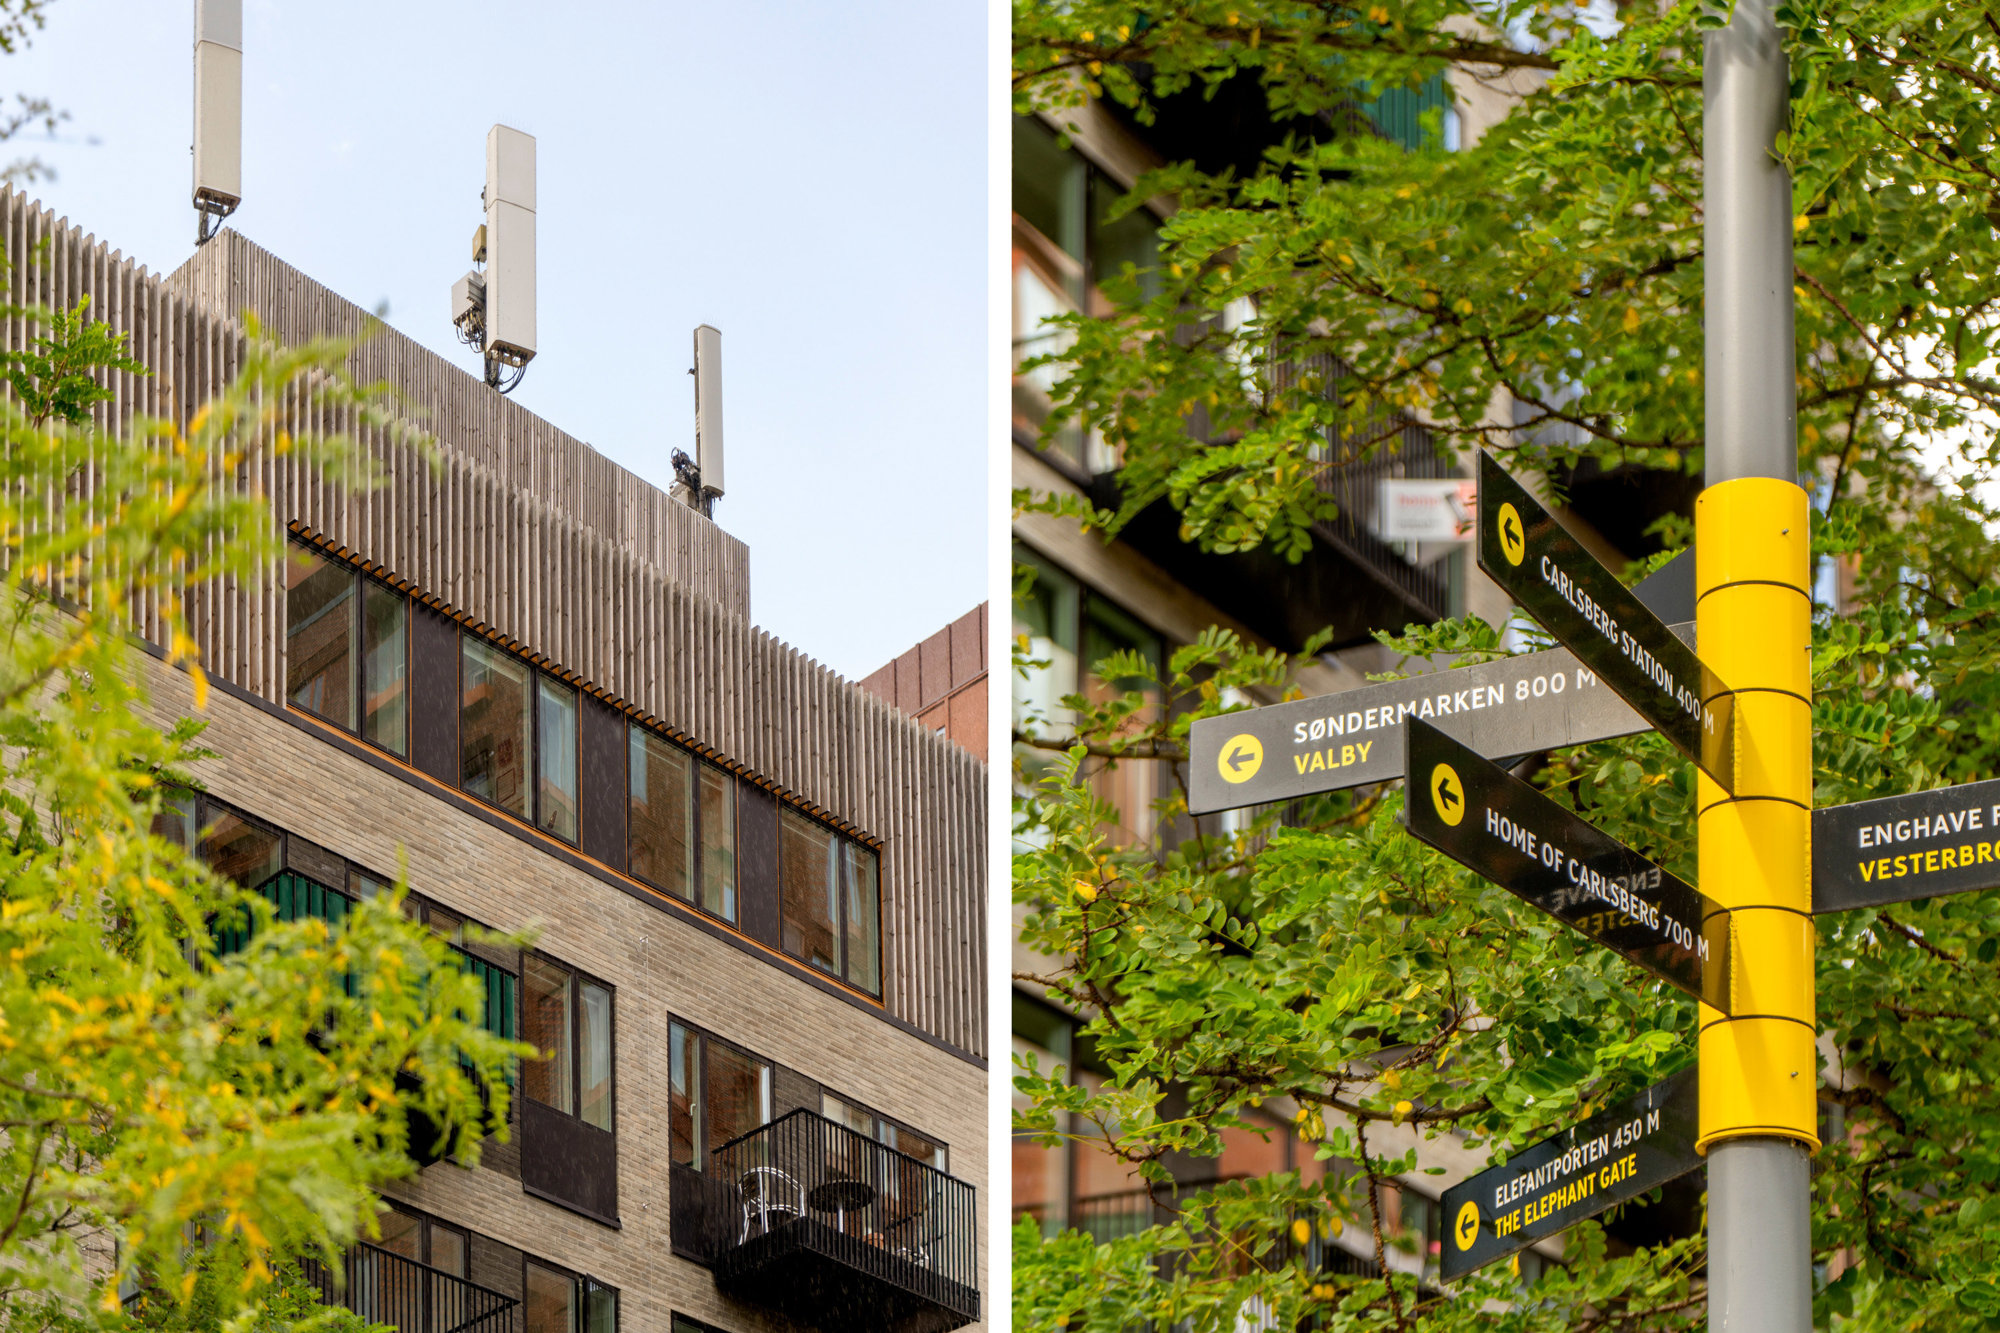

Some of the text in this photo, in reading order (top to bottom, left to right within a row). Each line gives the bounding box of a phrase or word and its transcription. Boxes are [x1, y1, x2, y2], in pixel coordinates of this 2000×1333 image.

[1541, 556, 1714, 735] CARLSBERG STATION 400 M
[1294, 669, 1596, 743] SØNDERMARKEN 800 M
[1294, 741, 1373, 774] VALBY
[1859, 808, 1983, 848] ENGHAVE
[1487, 808, 1709, 961] HOME OF CARLSBERG 700 M
[1495, 1153, 1637, 1239] THE ELEPHANT GATE
[1496, 1109, 1660, 1208] ELEFANTPORTEN 450 M
